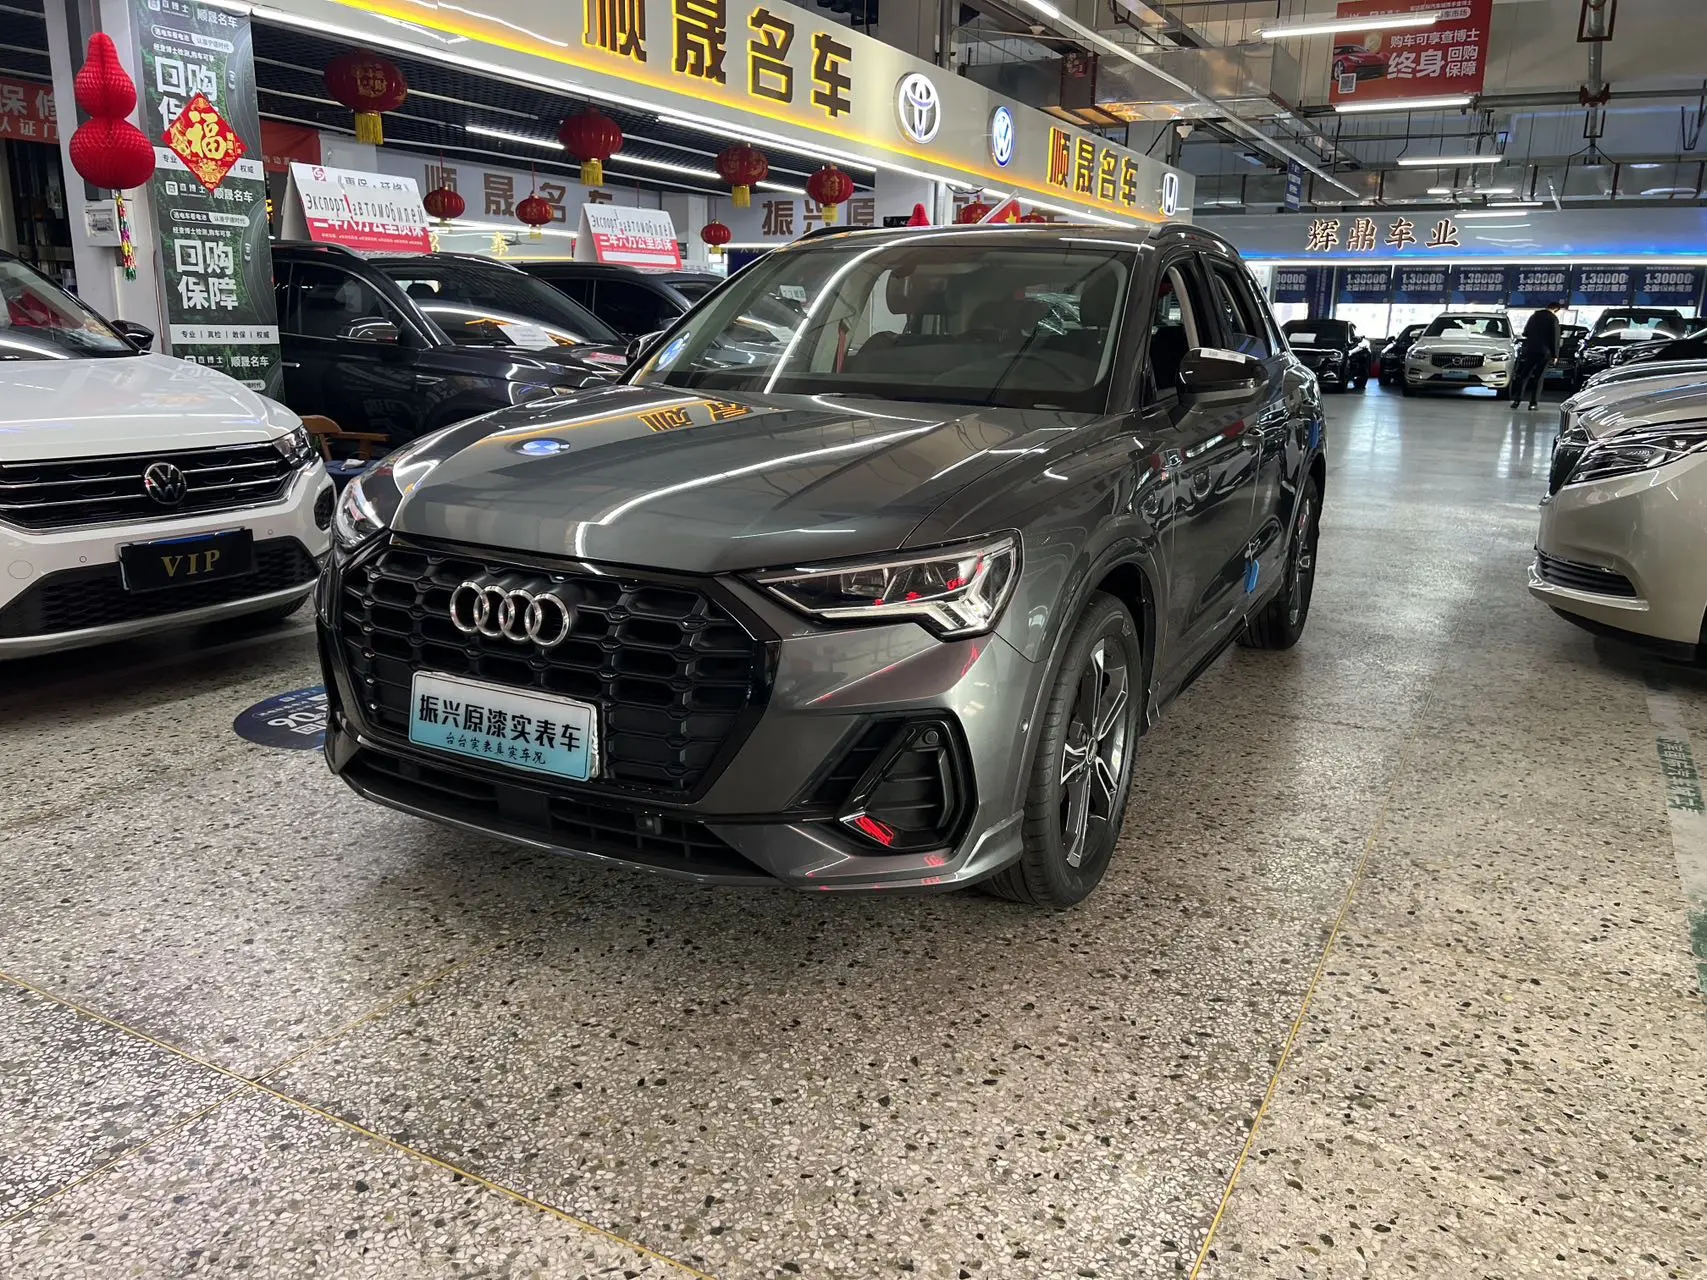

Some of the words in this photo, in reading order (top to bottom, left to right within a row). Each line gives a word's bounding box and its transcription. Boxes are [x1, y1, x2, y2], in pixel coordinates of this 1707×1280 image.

[1390, 28, 1480, 48] 购车可享查博士
[155, 56, 218, 101] 回购
[1387, 49, 1445, 79] 终身
[1448, 46, 1477, 61] 回购
[1446, 62, 1477, 77] 保障
[186, 110, 227, 160] 福
[1047, 126, 1139, 207] 顺晟名车
[305, 193, 346, 217] Экспорт
[1306, 217, 1461, 251] 辉鼎车业
[174, 239, 235, 275] 回购
[177, 275, 239, 310] 保障
[161, 550, 220, 577] VIP
[419, 693, 582, 753] 振兴原漆实表车
[445, 731, 546, 765] 台台实表真实车况
